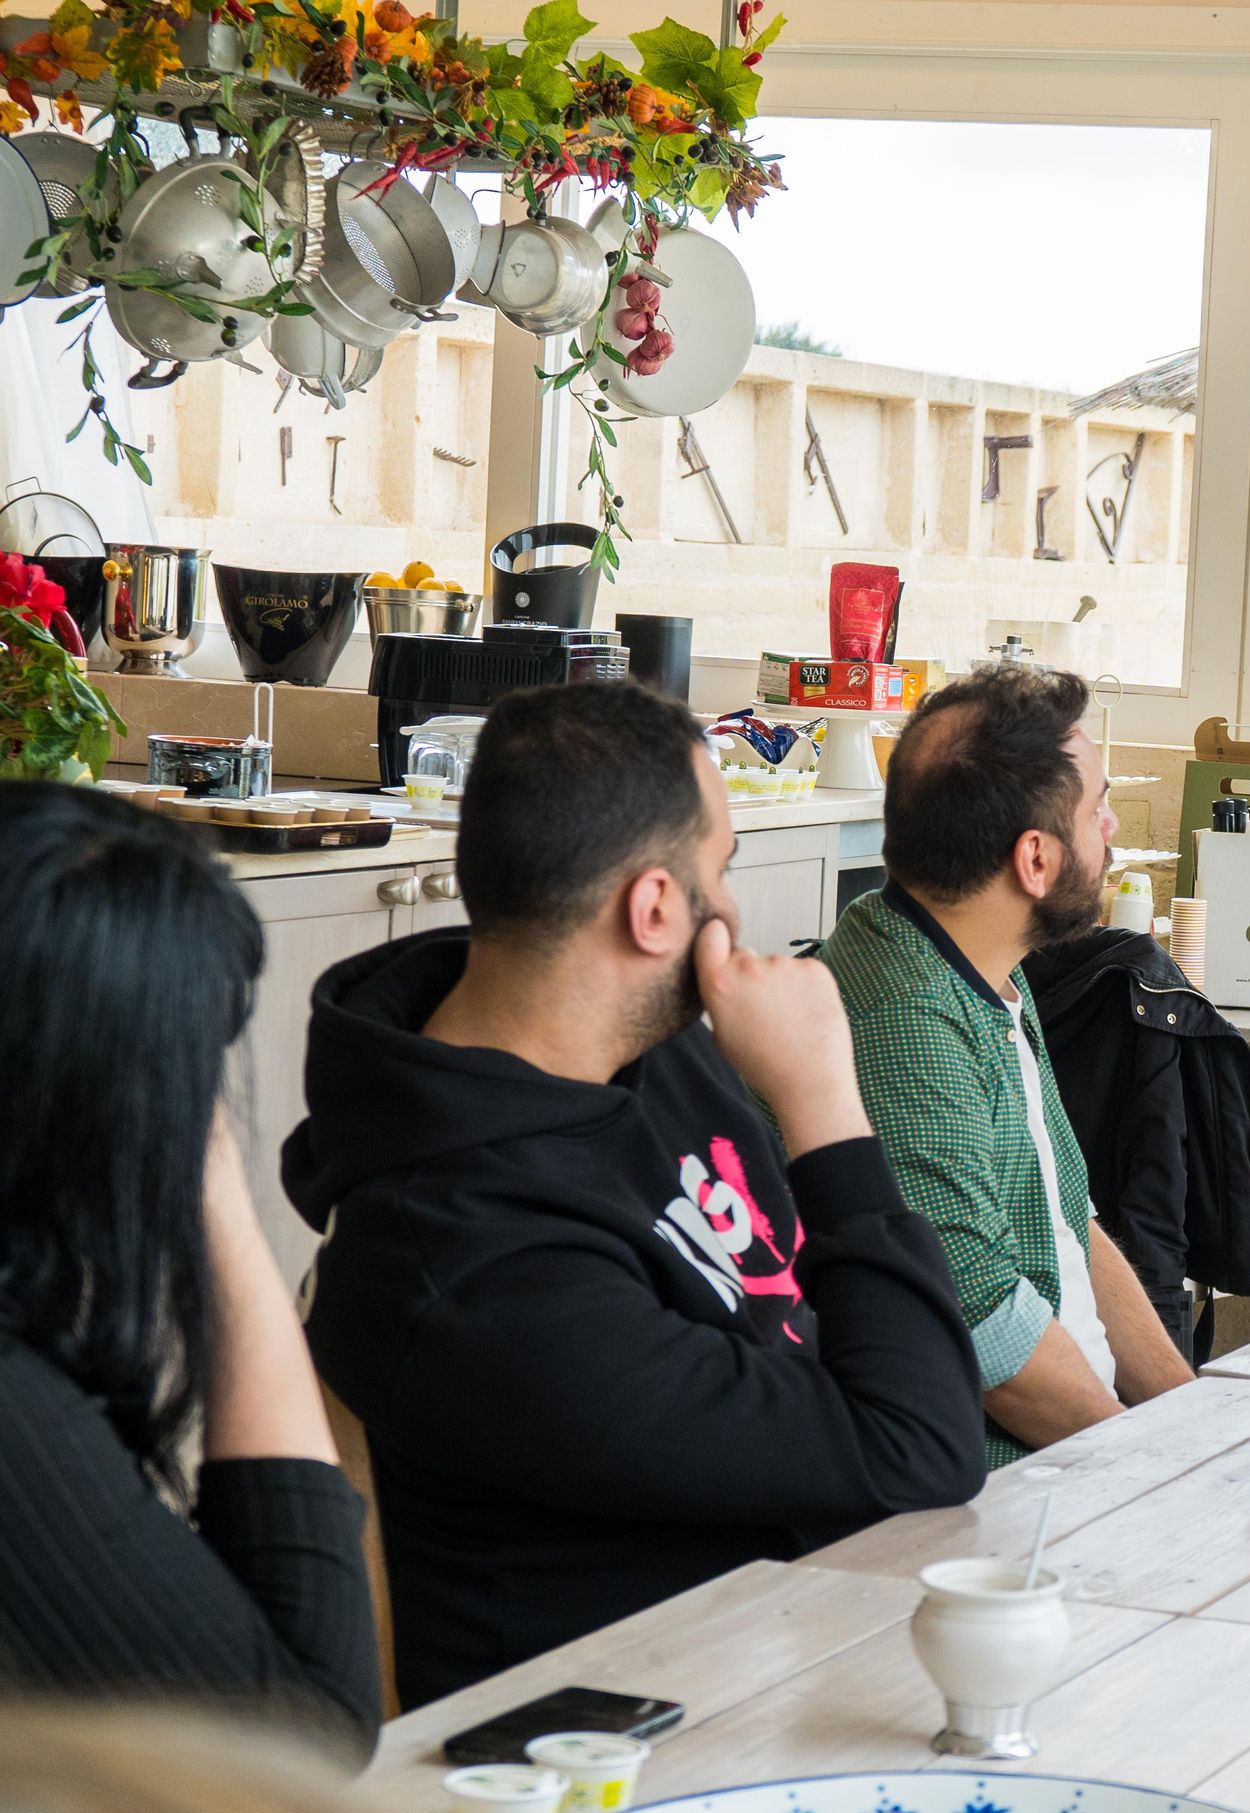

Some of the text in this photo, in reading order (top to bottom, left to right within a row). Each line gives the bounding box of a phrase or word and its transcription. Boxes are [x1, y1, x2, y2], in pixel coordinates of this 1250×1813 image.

[245, 596, 308, 609] GIROLAMO
[802, 667, 826, 675] STAR
[805, 675, 824, 683] TEA
